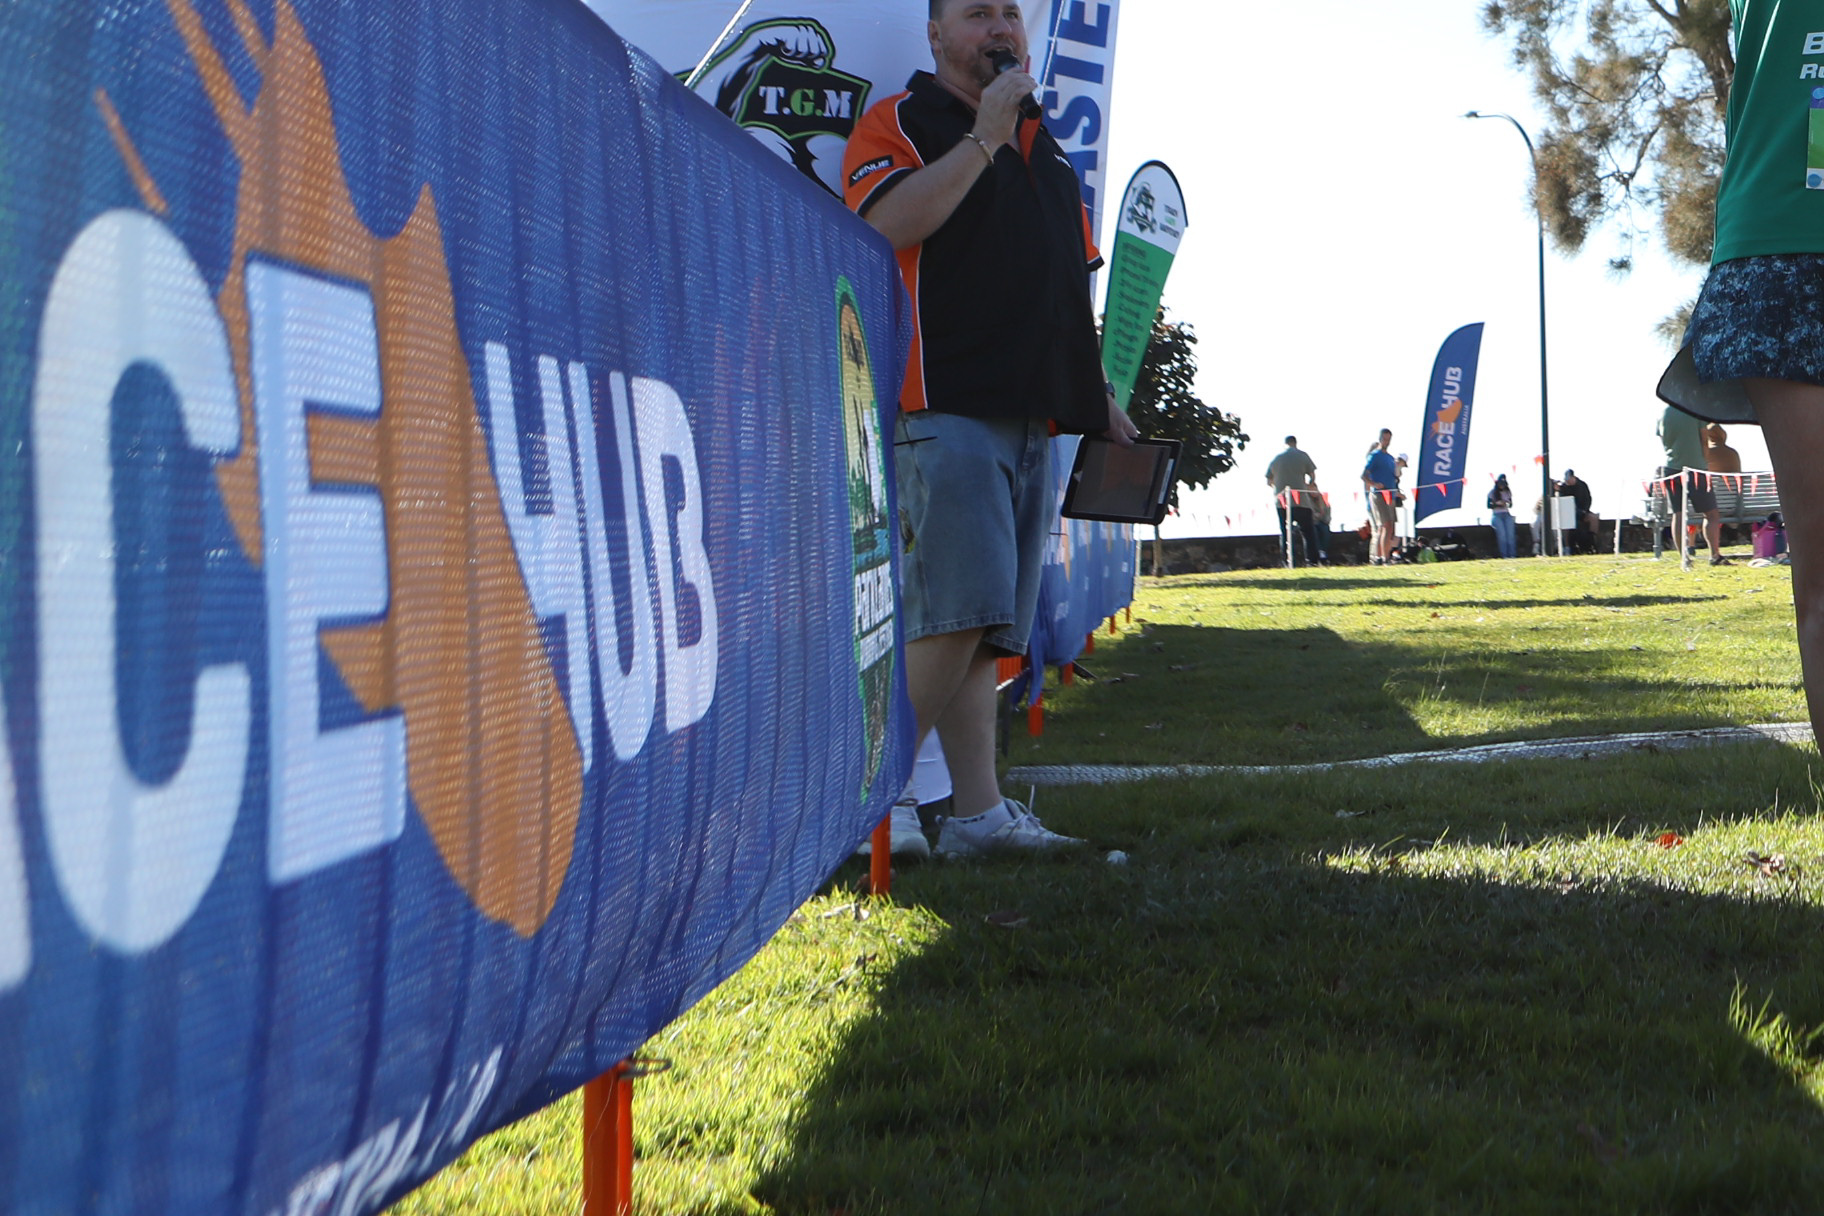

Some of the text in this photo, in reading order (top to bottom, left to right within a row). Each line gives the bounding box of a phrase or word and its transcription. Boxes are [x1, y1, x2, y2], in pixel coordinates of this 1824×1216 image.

[759, 85, 853, 119] T.G.M
[1434, 366, 1463, 476] RACE HUB
[484, 340, 718, 773] HUB
